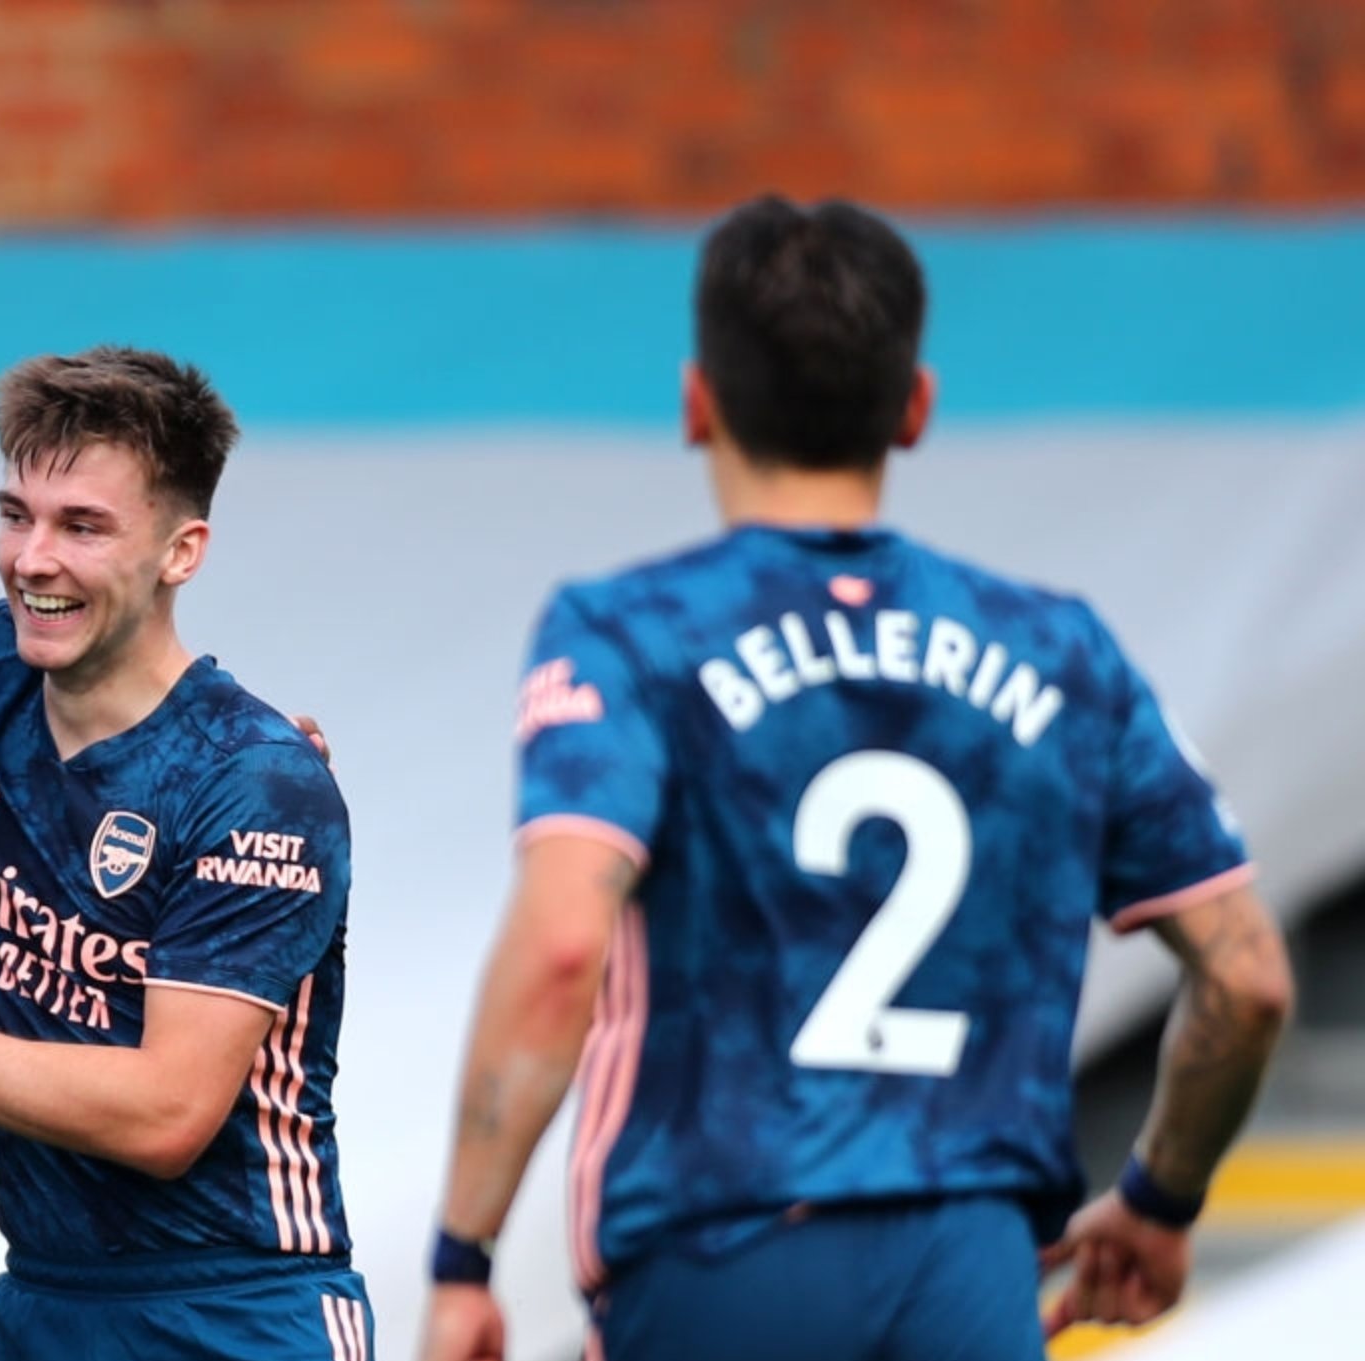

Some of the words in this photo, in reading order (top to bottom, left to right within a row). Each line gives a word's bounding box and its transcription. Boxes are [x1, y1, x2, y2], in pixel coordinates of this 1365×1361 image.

[699, 610, 1066, 748] BELLERIN
[196, 856, 321, 893] RWANDA
[229, 829, 305, 861] VISIT
[789, 749, 972, 1077] 2
